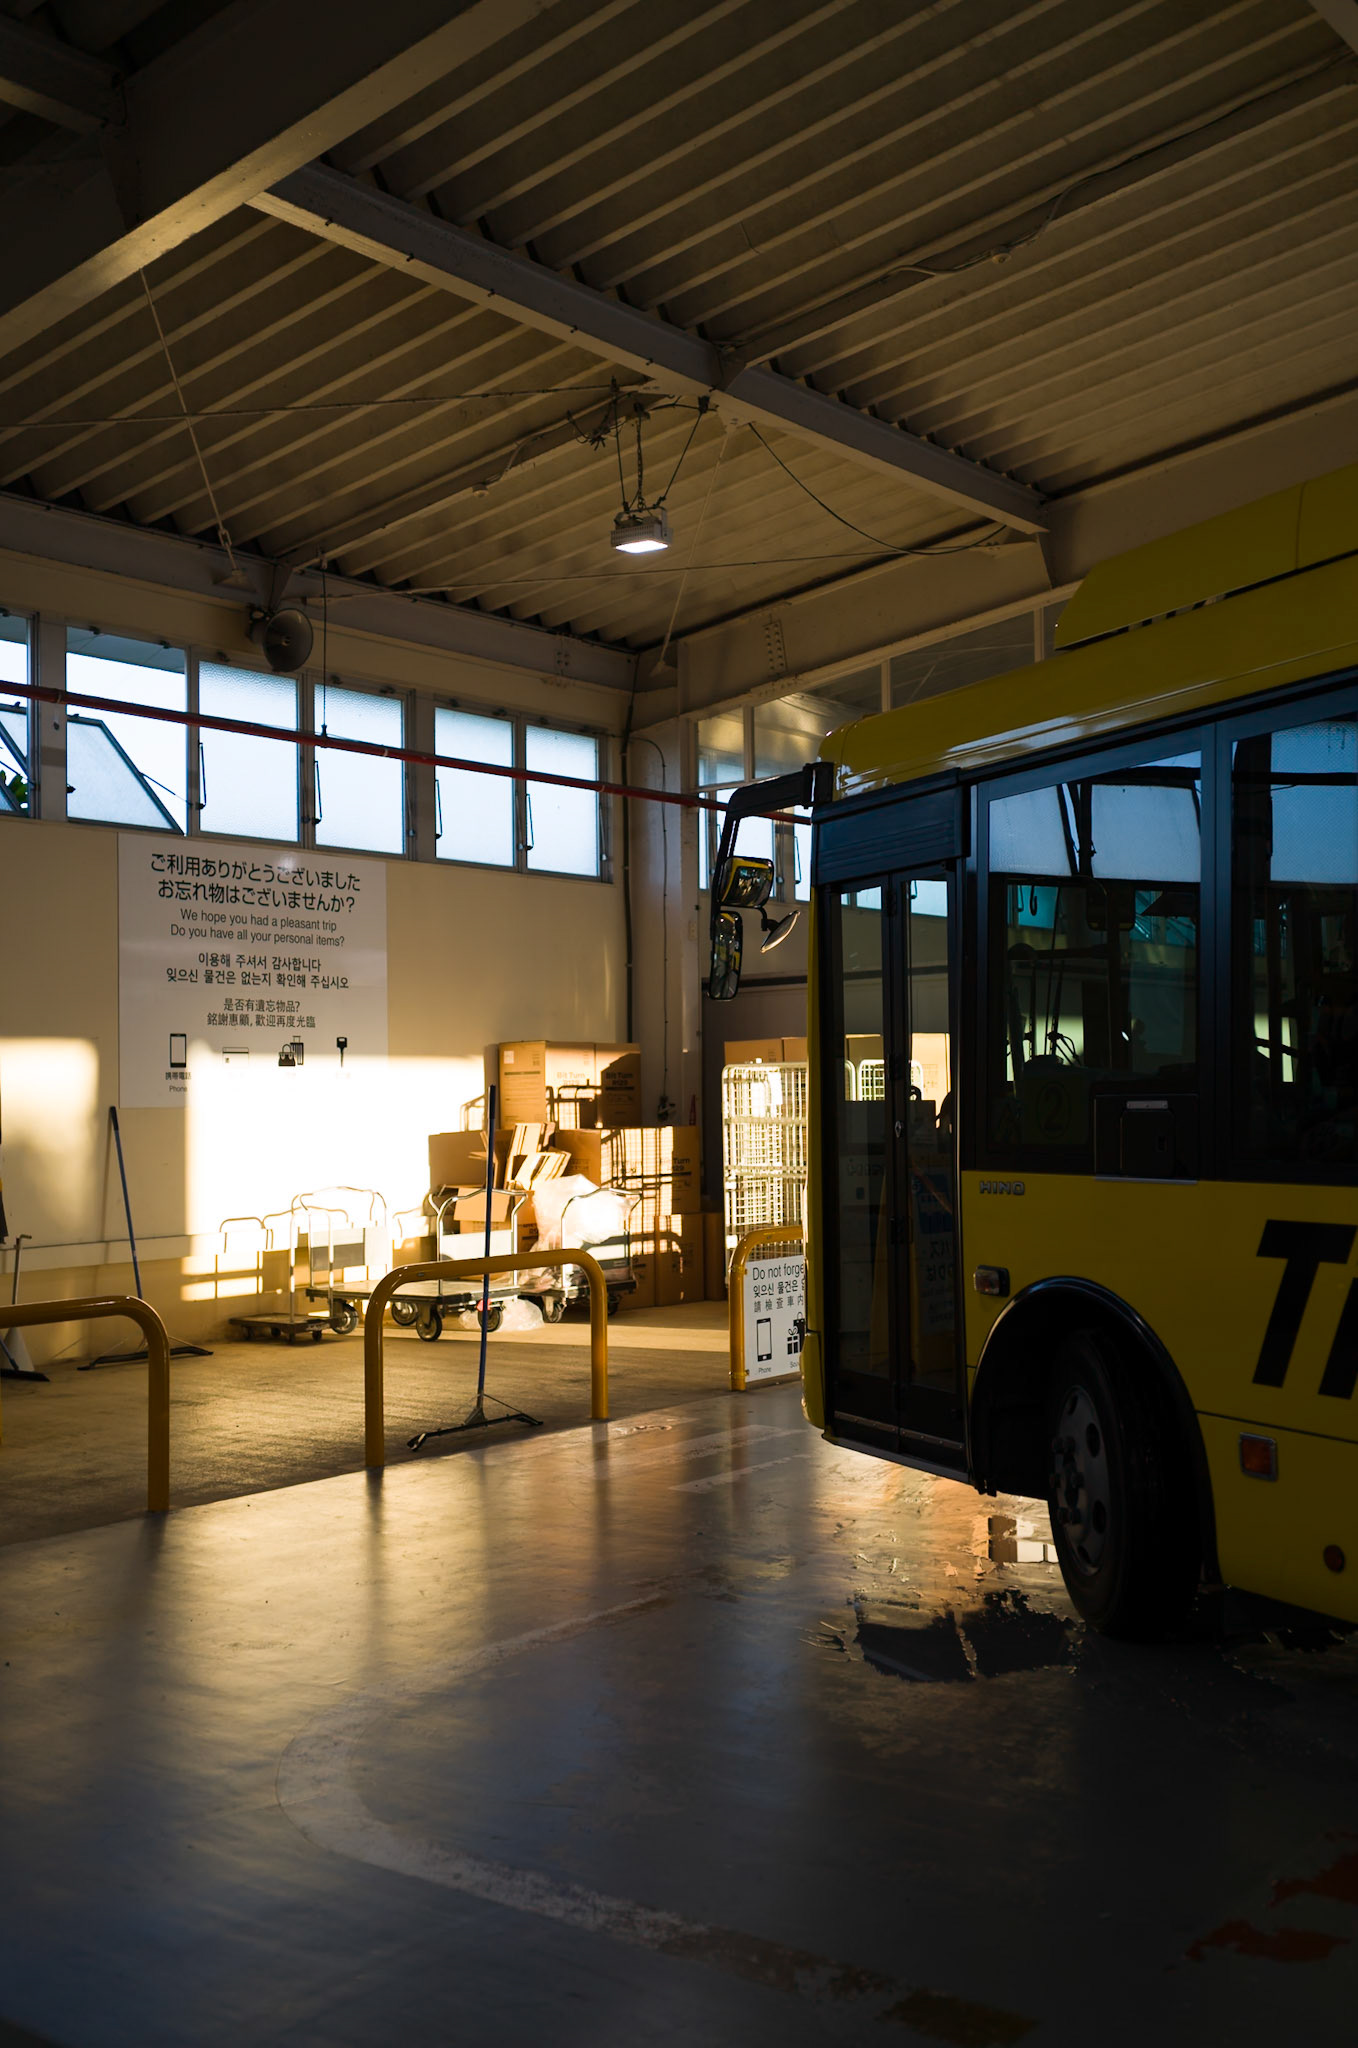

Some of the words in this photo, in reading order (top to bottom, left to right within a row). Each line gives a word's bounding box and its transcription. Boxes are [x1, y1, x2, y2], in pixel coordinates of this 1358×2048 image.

[151, 853, 361, 892] ご利用ありがとうございました
[158, 879, 355, 913] お忘れ物はございませんか?
[180, 908, 198, 921] We
[201, 910, 226, 925] hope
[229, 914, 248, 926] you
[250, 913, 269, 926] had
[272, 918, 279, 927] a
[280, 917, 321, 930] pleasant
[322, 920, 337, 933] trip
[170, 924, 186, 936] Do
[188, 927, 207, 939] you
[210, 926, 234, 939] have
[237, 929, 248, 940] all
[250, 932, 272, 943] your
[273, 933, 313, 945] personal
[316, 935, 345, 947] items?
[198, 952, 231, 968] 이용해
[235, 954, 267, 970] 주셔서
[271, 956, 322, 973] 감사합니다
[166, 967, 198, 983] 잊으신
[203, 969, 237, 985] 물건은
[240, 971, 272, 987] 없는지
[276, 972, 306, 988] 확인해
[310, 974, 349, 990] 주십시오
[979, 1181, 1025, 1195] HINO
[752, 1266, 766, 1281] Do
[767, 1265, 782, 1278] not
[753, 1283, 775, 1298] 잊으신
[777, 1280, 799, 1295] 물건은
